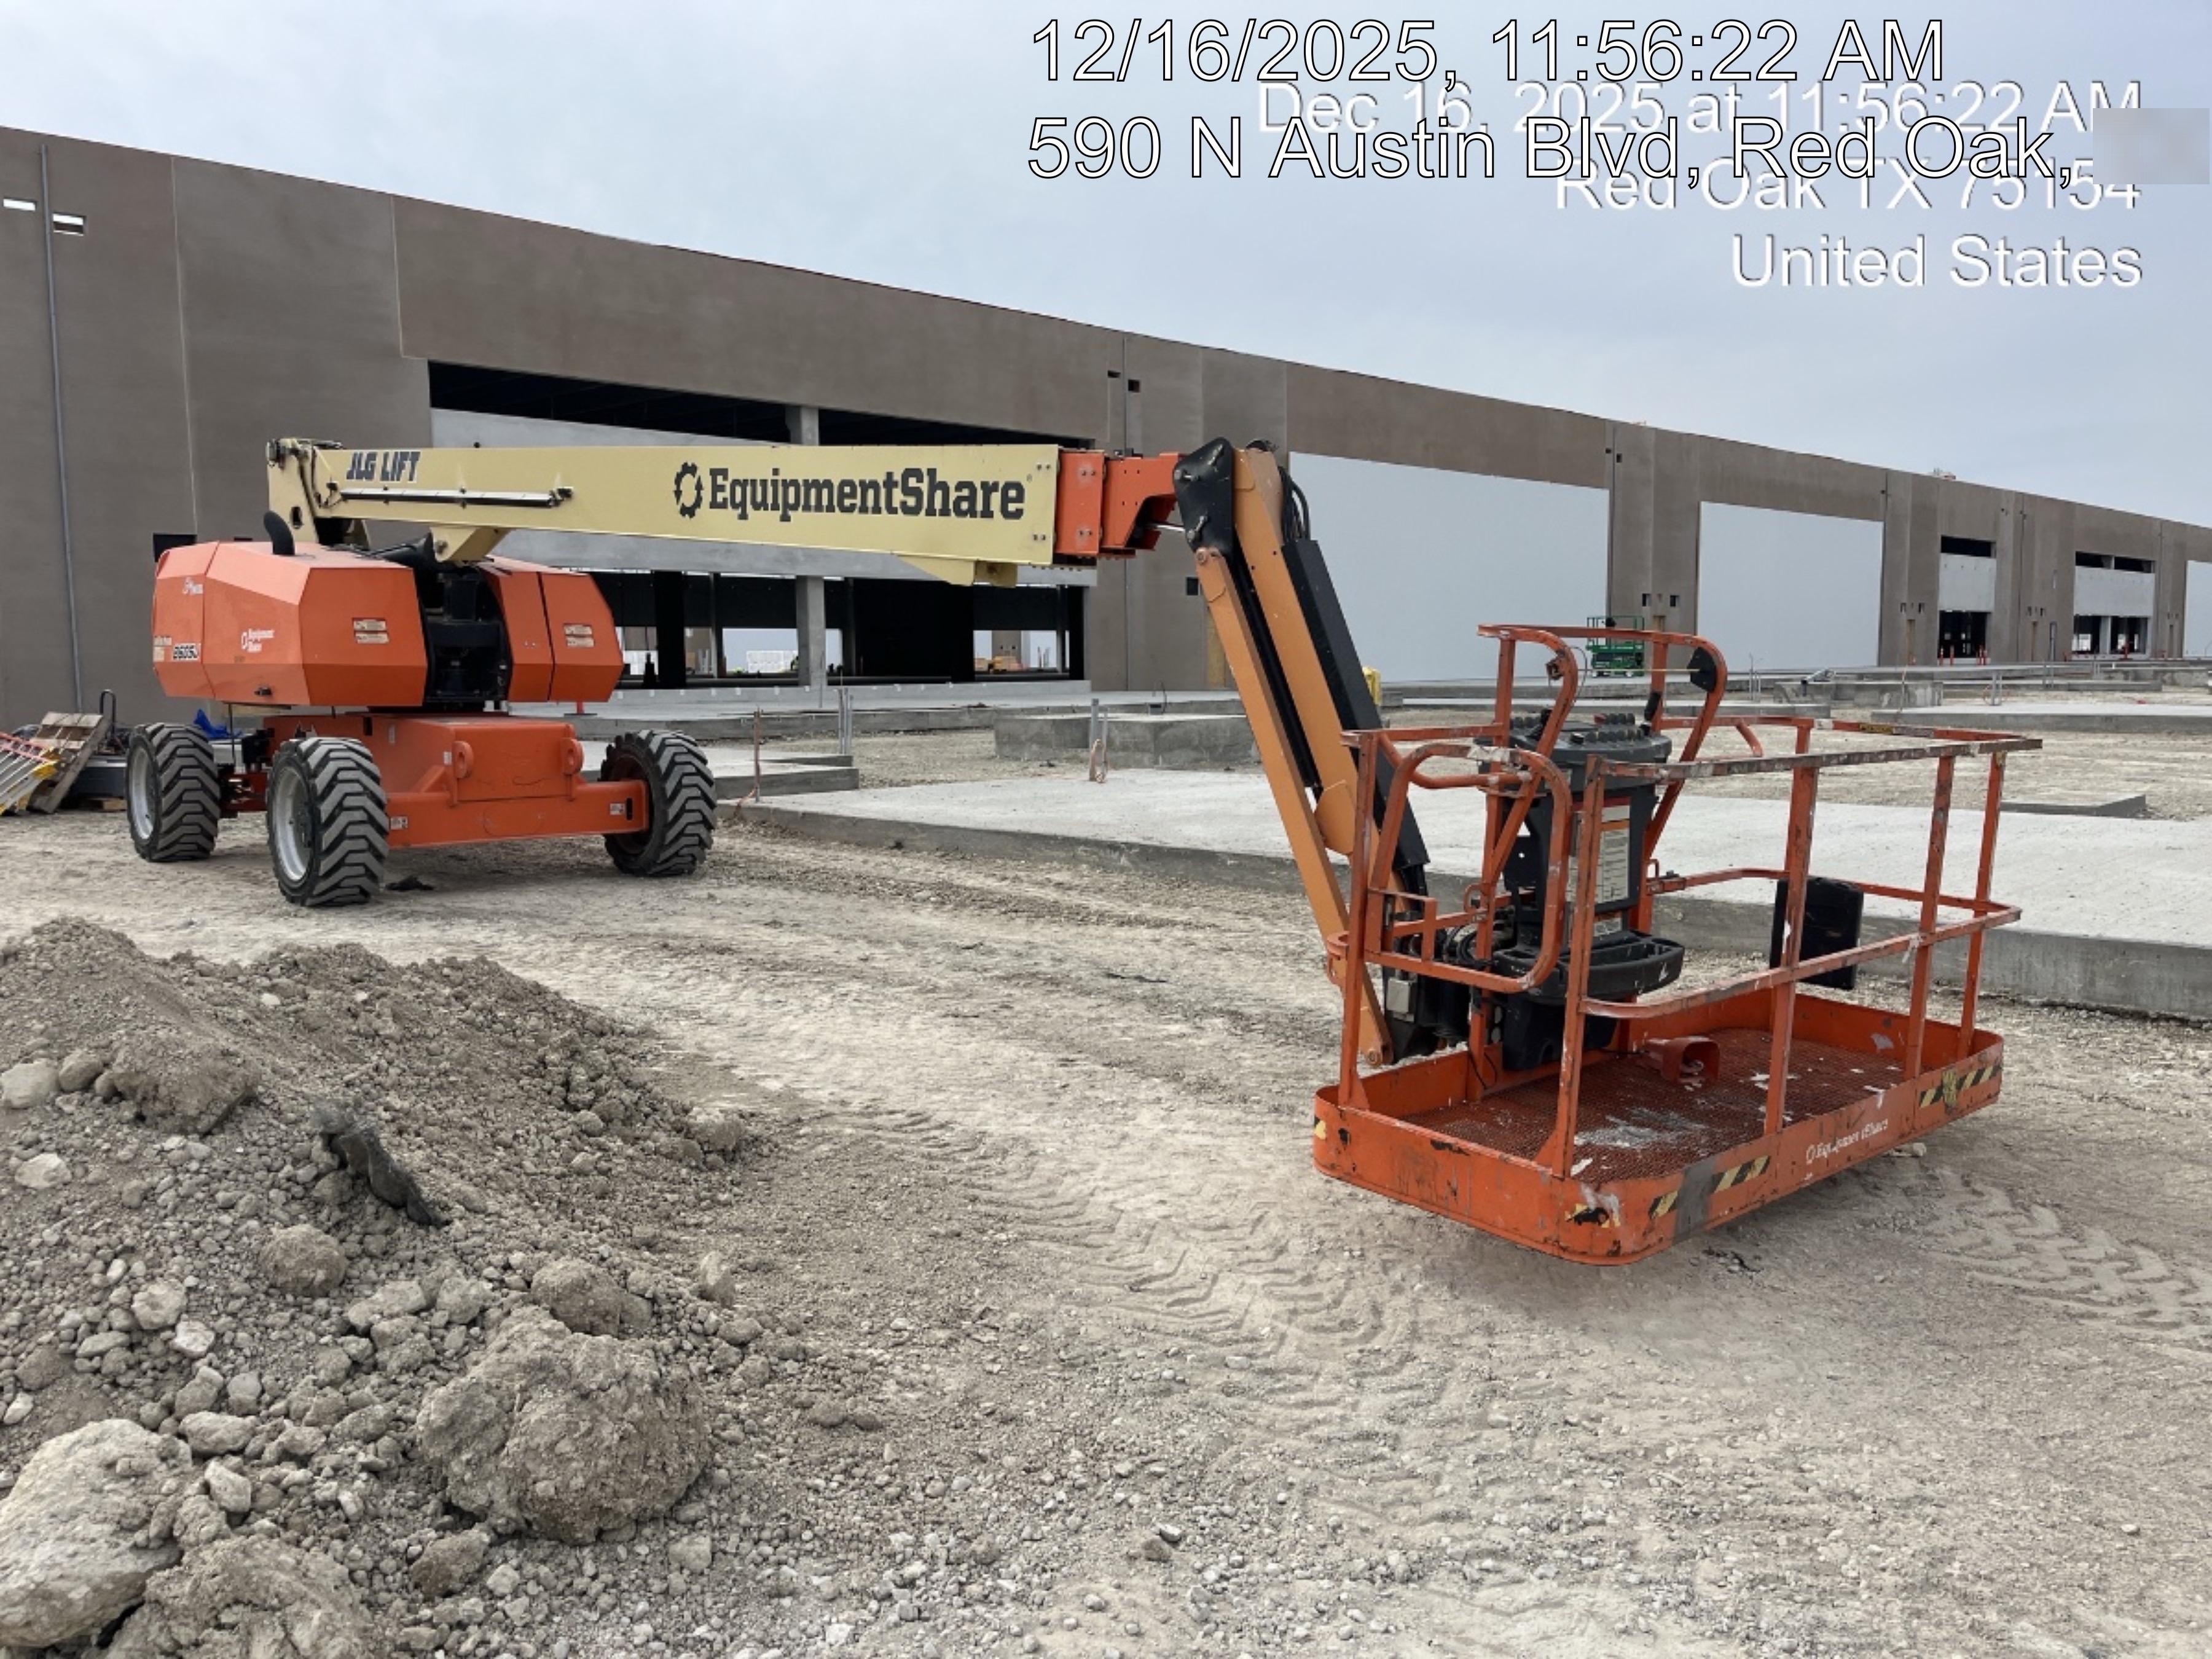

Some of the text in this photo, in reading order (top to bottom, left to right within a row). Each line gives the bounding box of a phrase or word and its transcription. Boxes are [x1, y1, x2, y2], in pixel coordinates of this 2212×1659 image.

[346, 452, 420, 482] JLG LIFT
[709, 468, 1025, 522] EquipmentShare
